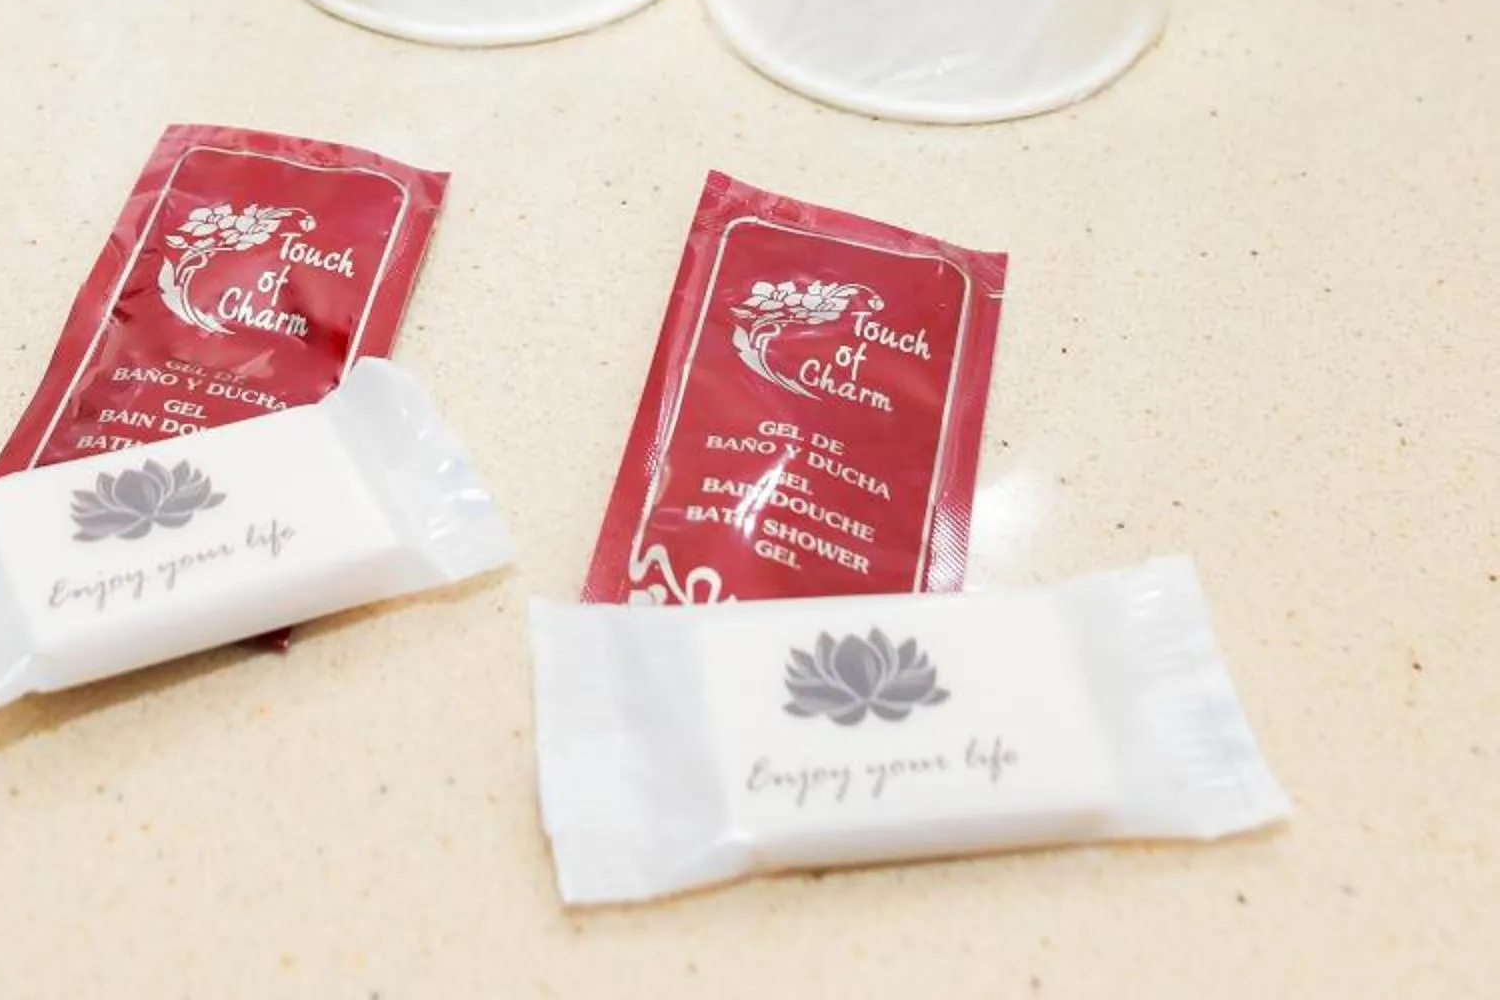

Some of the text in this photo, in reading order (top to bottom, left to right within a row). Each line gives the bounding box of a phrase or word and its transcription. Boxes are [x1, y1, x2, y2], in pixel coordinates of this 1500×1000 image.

[280, 233, 354, 278] Touch
[257, 264, 291, 306] of
[218, 287, 308, 336] Charm
[851, 311, 931, 360] Touch
[112, 366, 178, 385] BAÑO
[186, 377, 202, 391] Y
[835, 341, 867, 381] of
[799, 358, 893, 412] Charm
[99, 409, 156, 428] BAIN
[163, 399, 209, 419] GEL
[758, 420, 845, 456] GEL DE
[705, 435, 892, 501] BAÑO Y DUCHA
[767, 490, 876, 543] DOUCHE
[48, 518, 297, 612] Enjoy your life
[755, 539, 801, 570] GEL
[763, 518, 870, 575] SHOWER
[745, 734, 1020, 808] Enjoy your life
